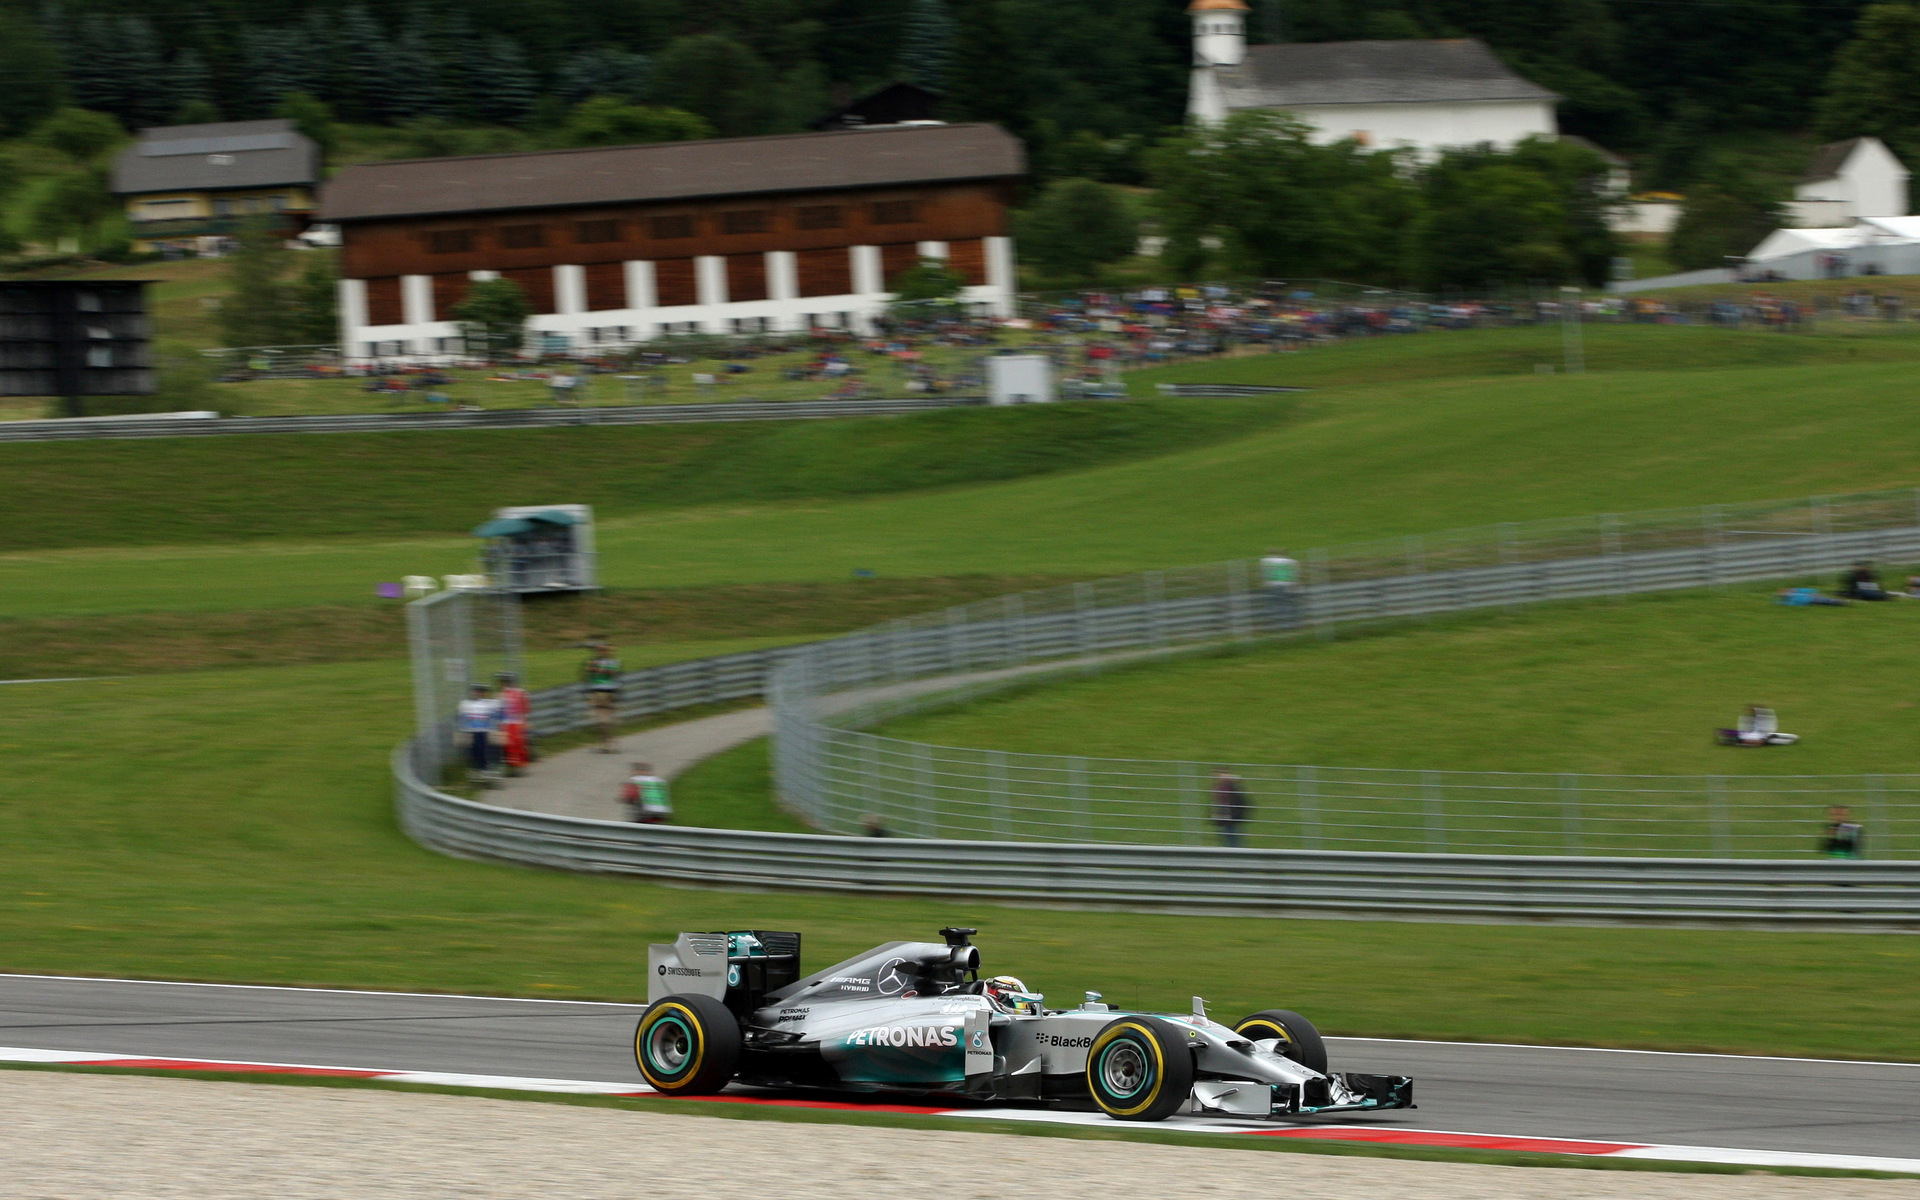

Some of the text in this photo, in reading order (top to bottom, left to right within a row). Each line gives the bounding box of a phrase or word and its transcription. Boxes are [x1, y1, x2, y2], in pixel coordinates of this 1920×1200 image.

[780, 1007, 810, 1015] PETRONAS
[845, 1026, 957, 1048] PETRONAS
[1051, 1035, 1093, 1048] BlackB
